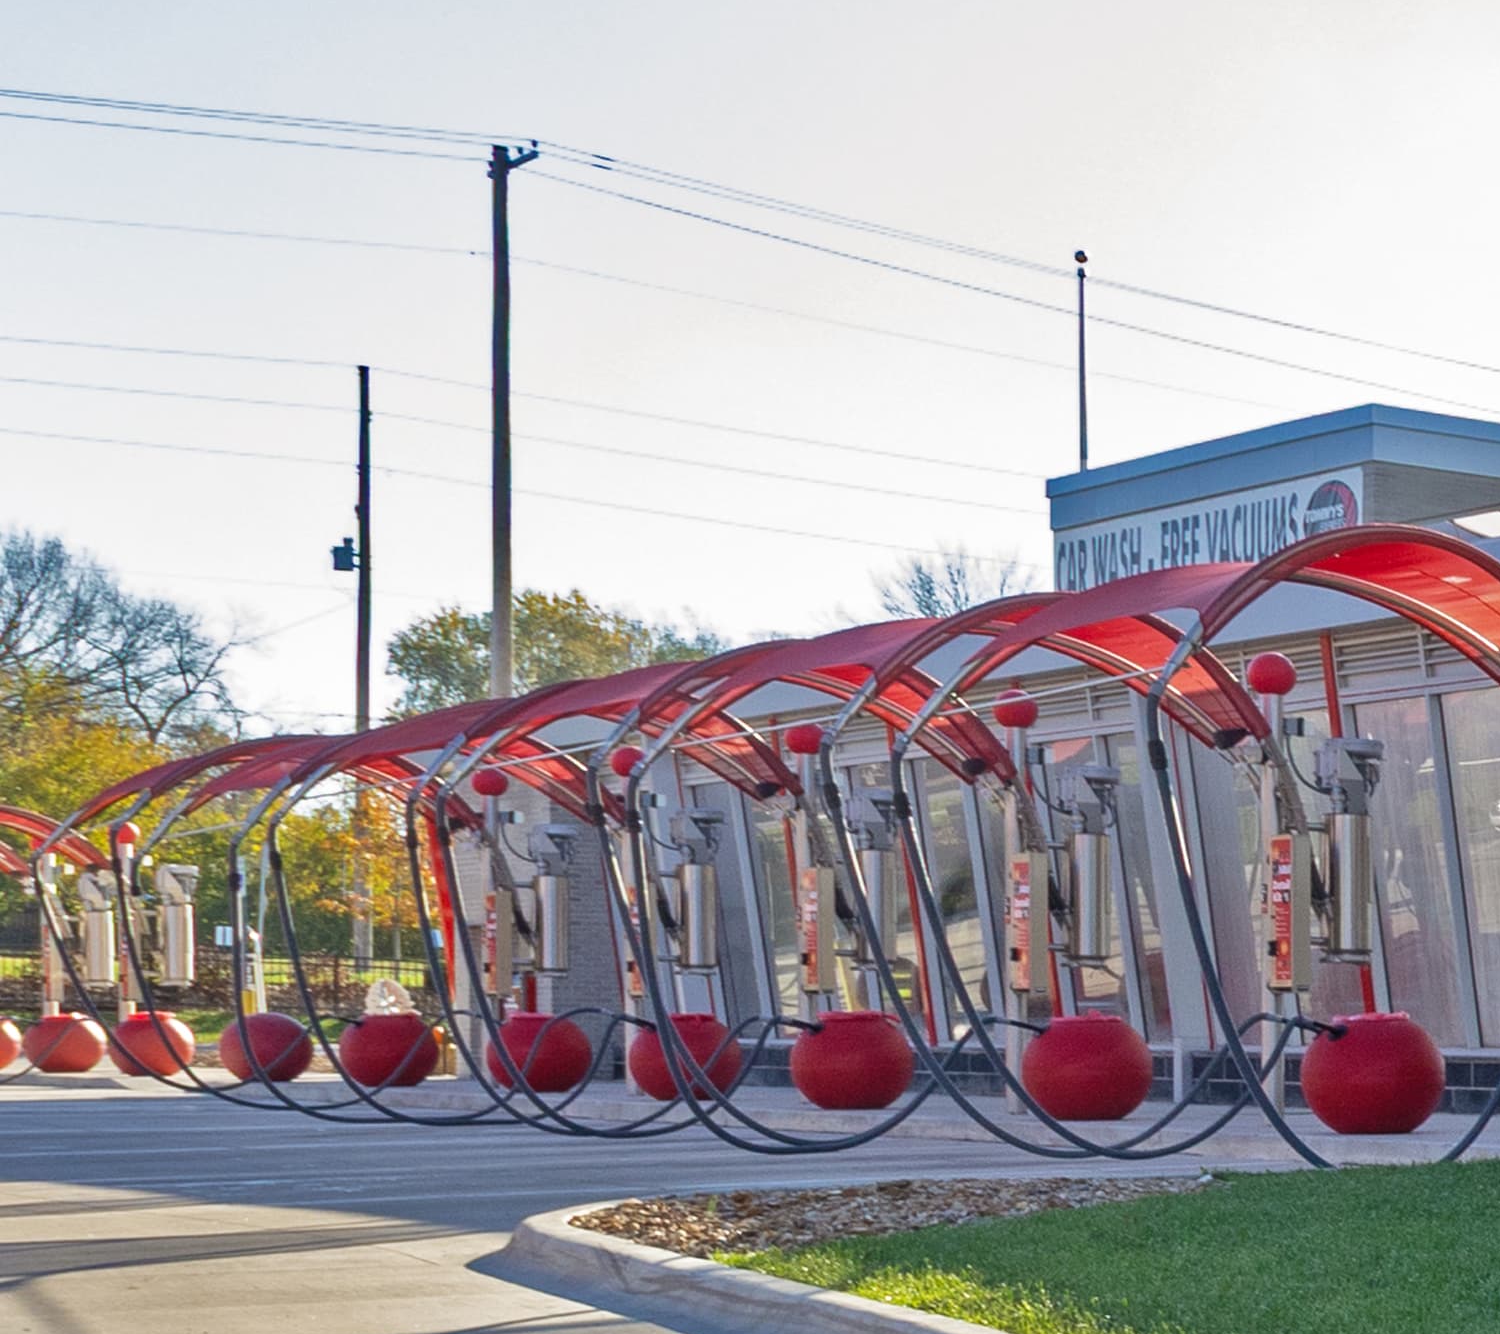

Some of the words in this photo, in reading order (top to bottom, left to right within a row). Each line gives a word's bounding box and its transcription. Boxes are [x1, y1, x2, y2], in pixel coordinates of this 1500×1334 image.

[1057, 539, 1087, 592] CAR
[1092, 527, 1142, 586] WASH
[1205, 492, 1299, 563] VACUUMS
